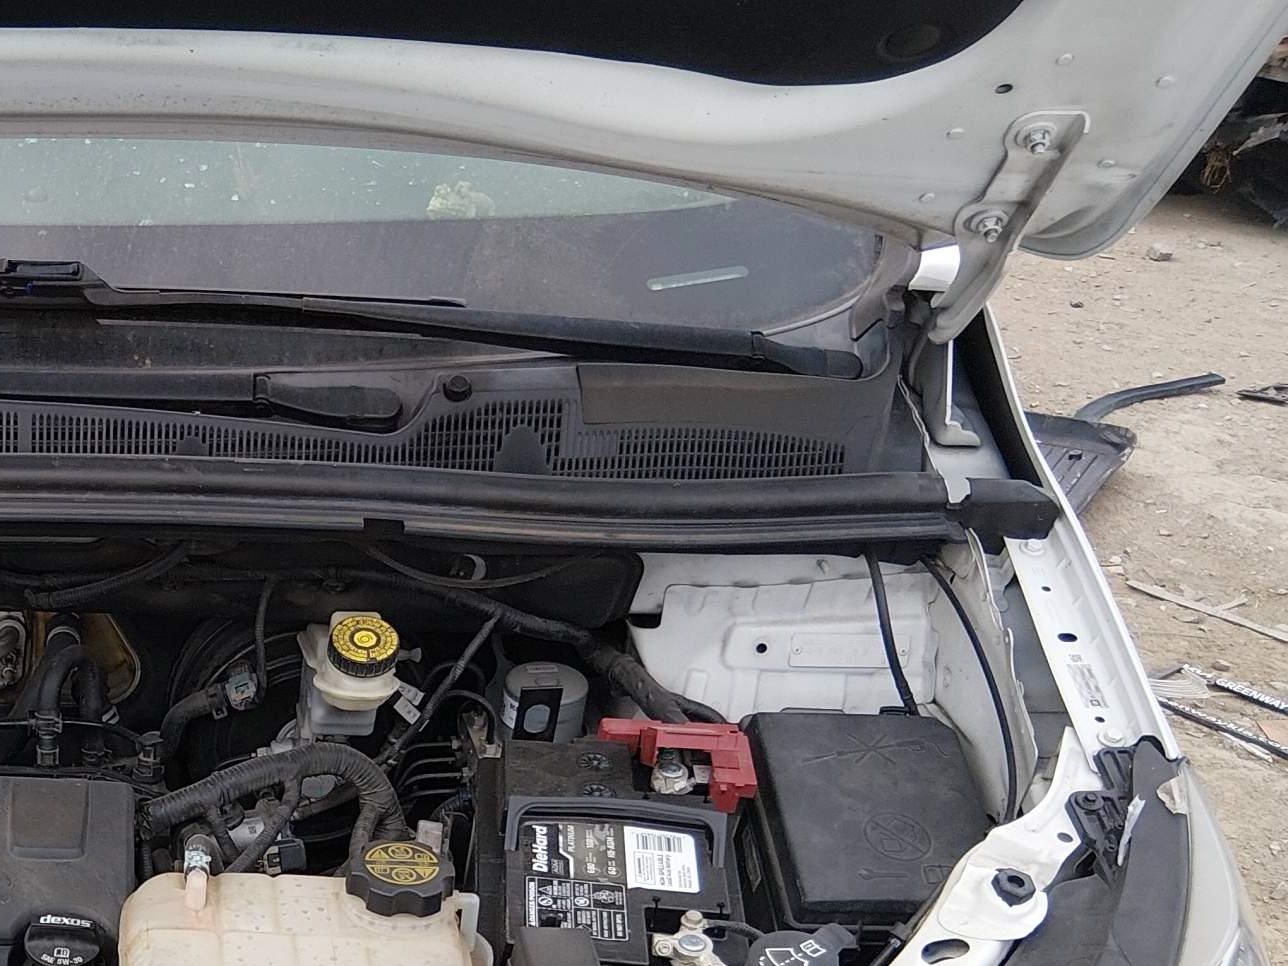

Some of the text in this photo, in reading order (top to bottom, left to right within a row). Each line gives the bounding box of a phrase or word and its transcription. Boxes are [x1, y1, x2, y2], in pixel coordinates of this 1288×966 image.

[1215, 678, 1288, 710] GREENWAY
[532, 825, 549, 873] DieHard
[567, 825, 576, 852] PLATINUM
[39, 914, 93, 928] dexos
[40, 953, 55, 964] SAE
